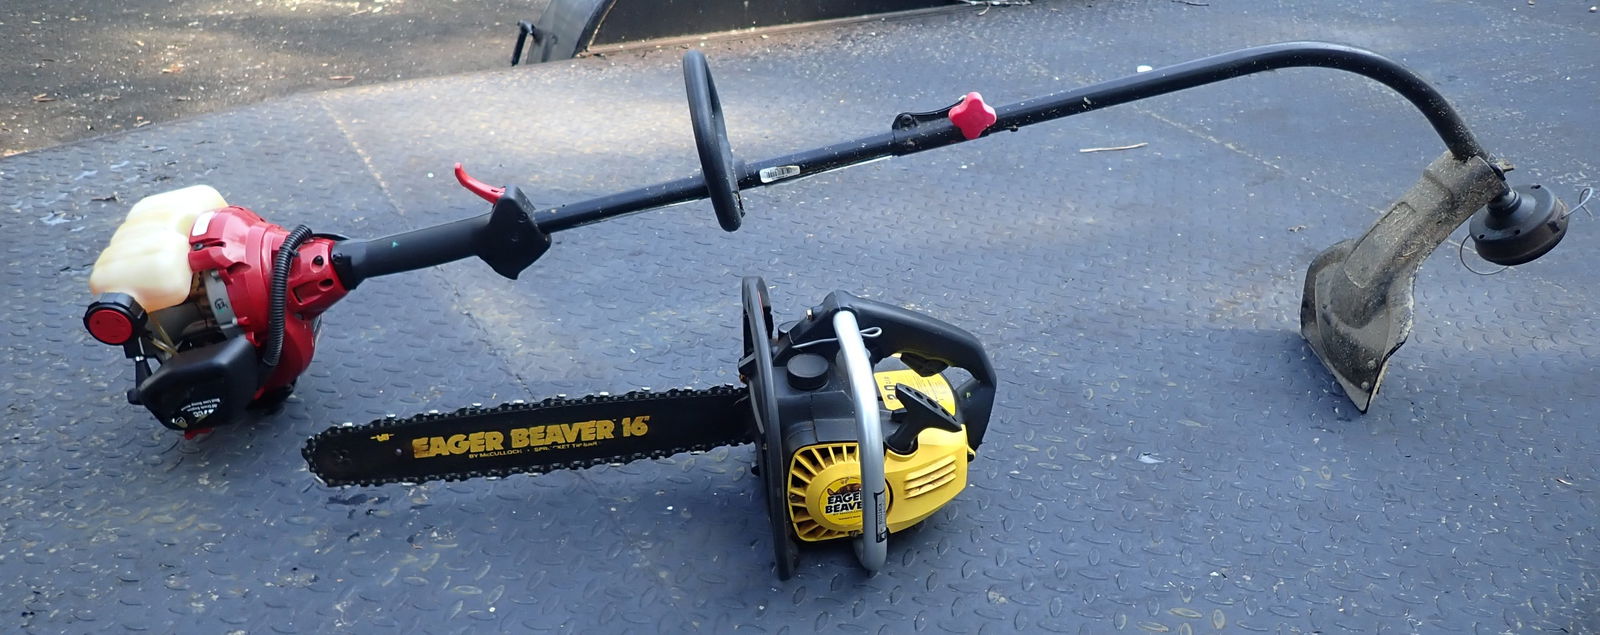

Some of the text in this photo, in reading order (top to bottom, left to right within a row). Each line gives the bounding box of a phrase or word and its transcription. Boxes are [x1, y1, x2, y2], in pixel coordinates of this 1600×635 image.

[411, 431, 504, 459] EAGER
[510, 420, 615, 448] BEAVER
[827, 491, 862, 504] EAGE
[825, 501, 863, 513] BEAVE
